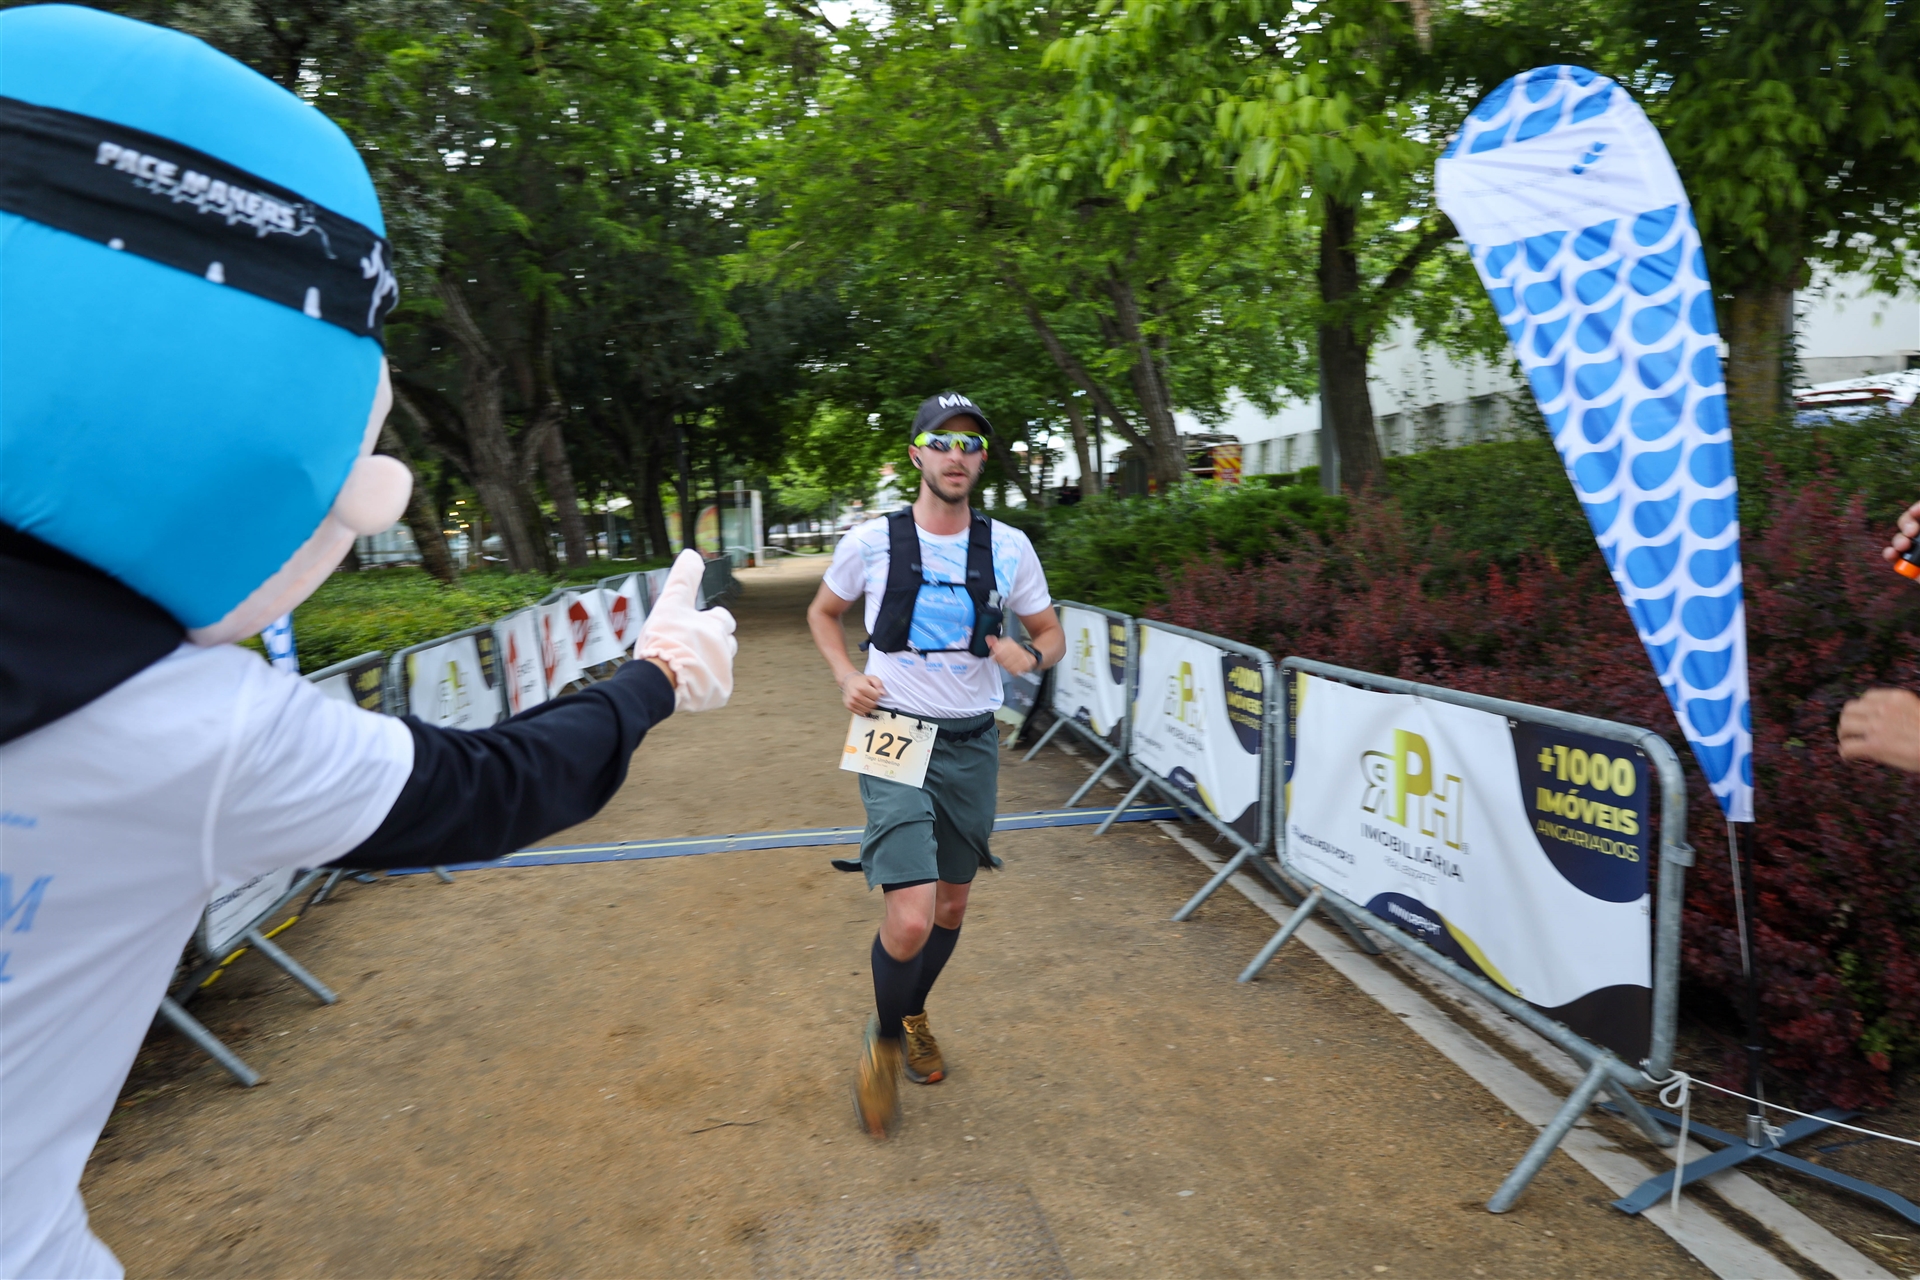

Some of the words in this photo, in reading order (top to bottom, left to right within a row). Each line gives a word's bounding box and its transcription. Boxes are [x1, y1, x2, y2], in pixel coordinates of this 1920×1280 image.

[95, 141, 179, 186] PACE
[182, 170, 296, 231] MAKERS
[865, 729, 913, 760] 127
[1537, 744, 1637, 797] +1000
[1536, 786, 1639, 836] IMÓVEIS
[1361, 823, 1465, 882] IMOBILIÁRIA
